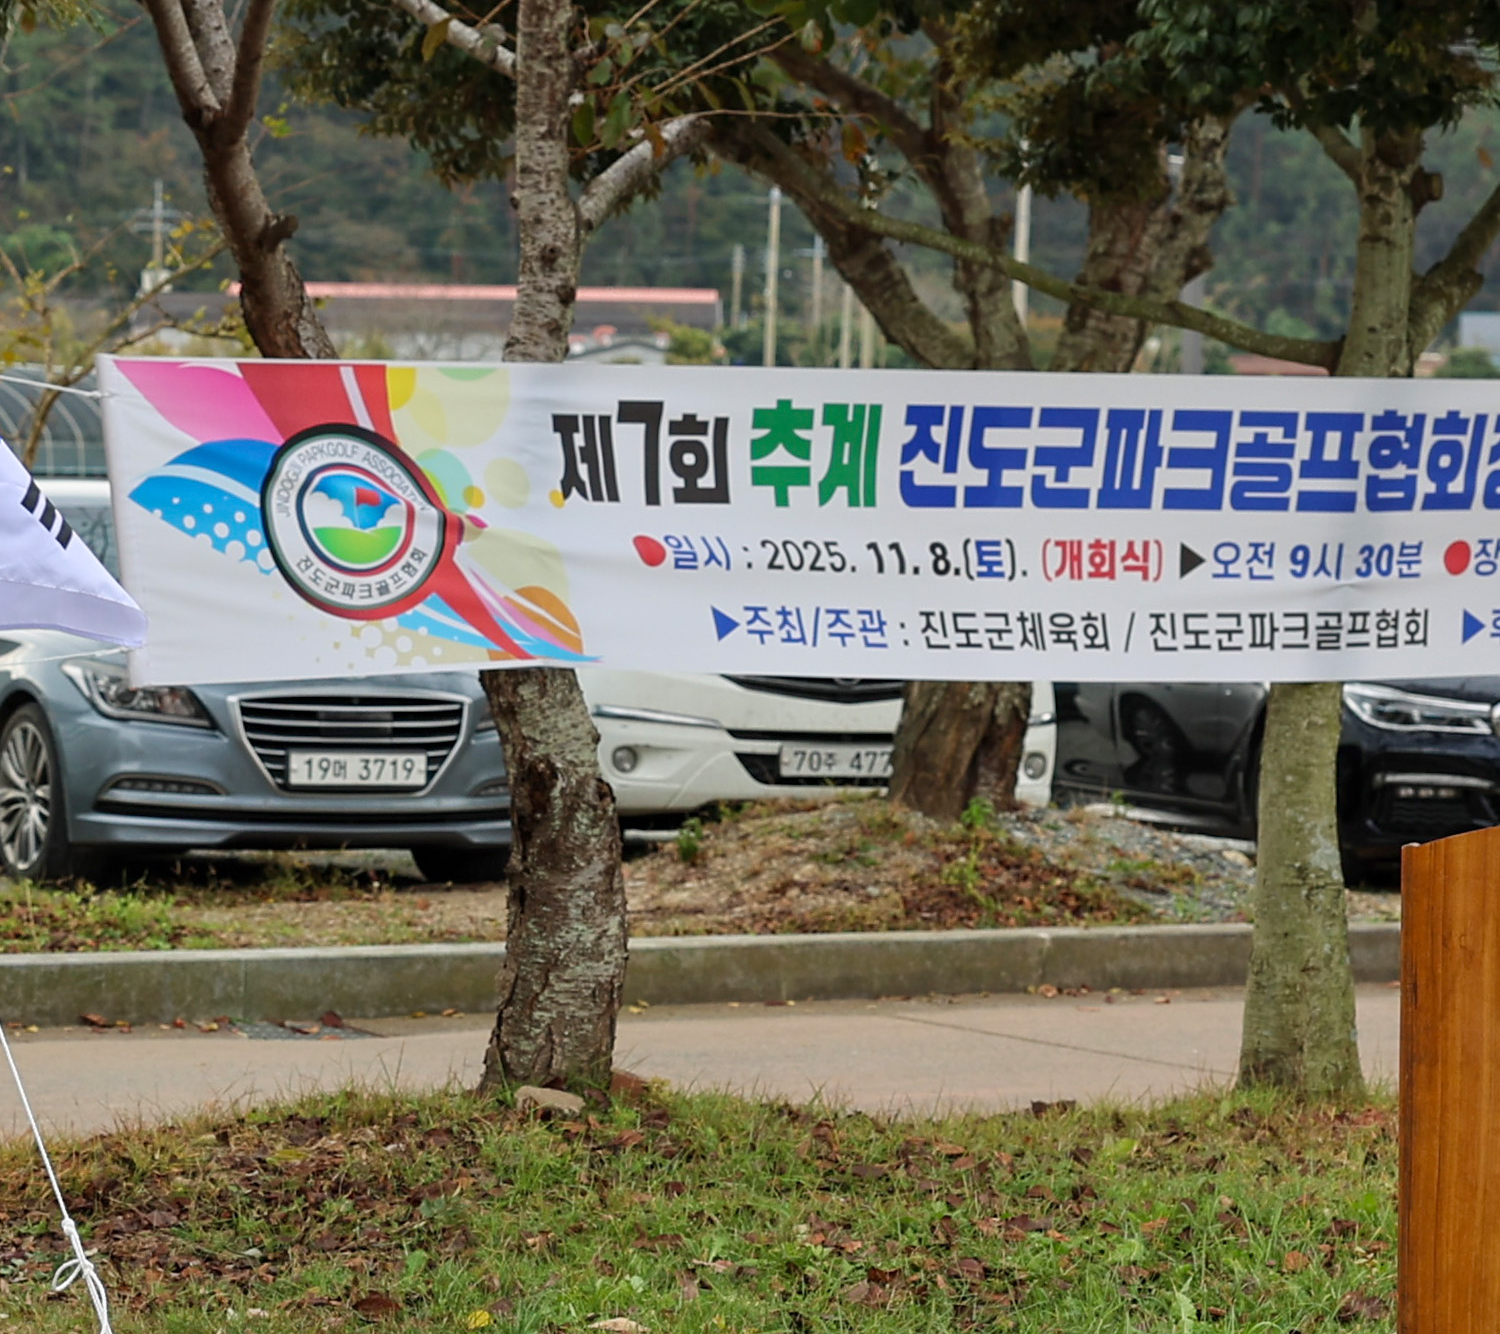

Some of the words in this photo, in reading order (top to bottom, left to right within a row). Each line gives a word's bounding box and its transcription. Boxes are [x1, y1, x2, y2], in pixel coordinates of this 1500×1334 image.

[552, 399, 731, 506] 제7회
[749, 399, 883, 507] 추계
[663, 534, 732, 571] 일시
[760, 539, 857, 574] 2025.
[1041, 537, 1163, 583] (개회식)
[1211, 541, 1275, 581] 오전
[1288, 541, 1344, 581] 9시
[1355, 540, 1424, 579] 30분
[742, 605, 889, 649] 주최/주관
[918, 610, 1111, 652] 진도군체육회
[1149, 607, 1430, 652] 진도군파크골프협회
[358, 757, 416, 782] 3719
[849, 750, 892, 774] 477
